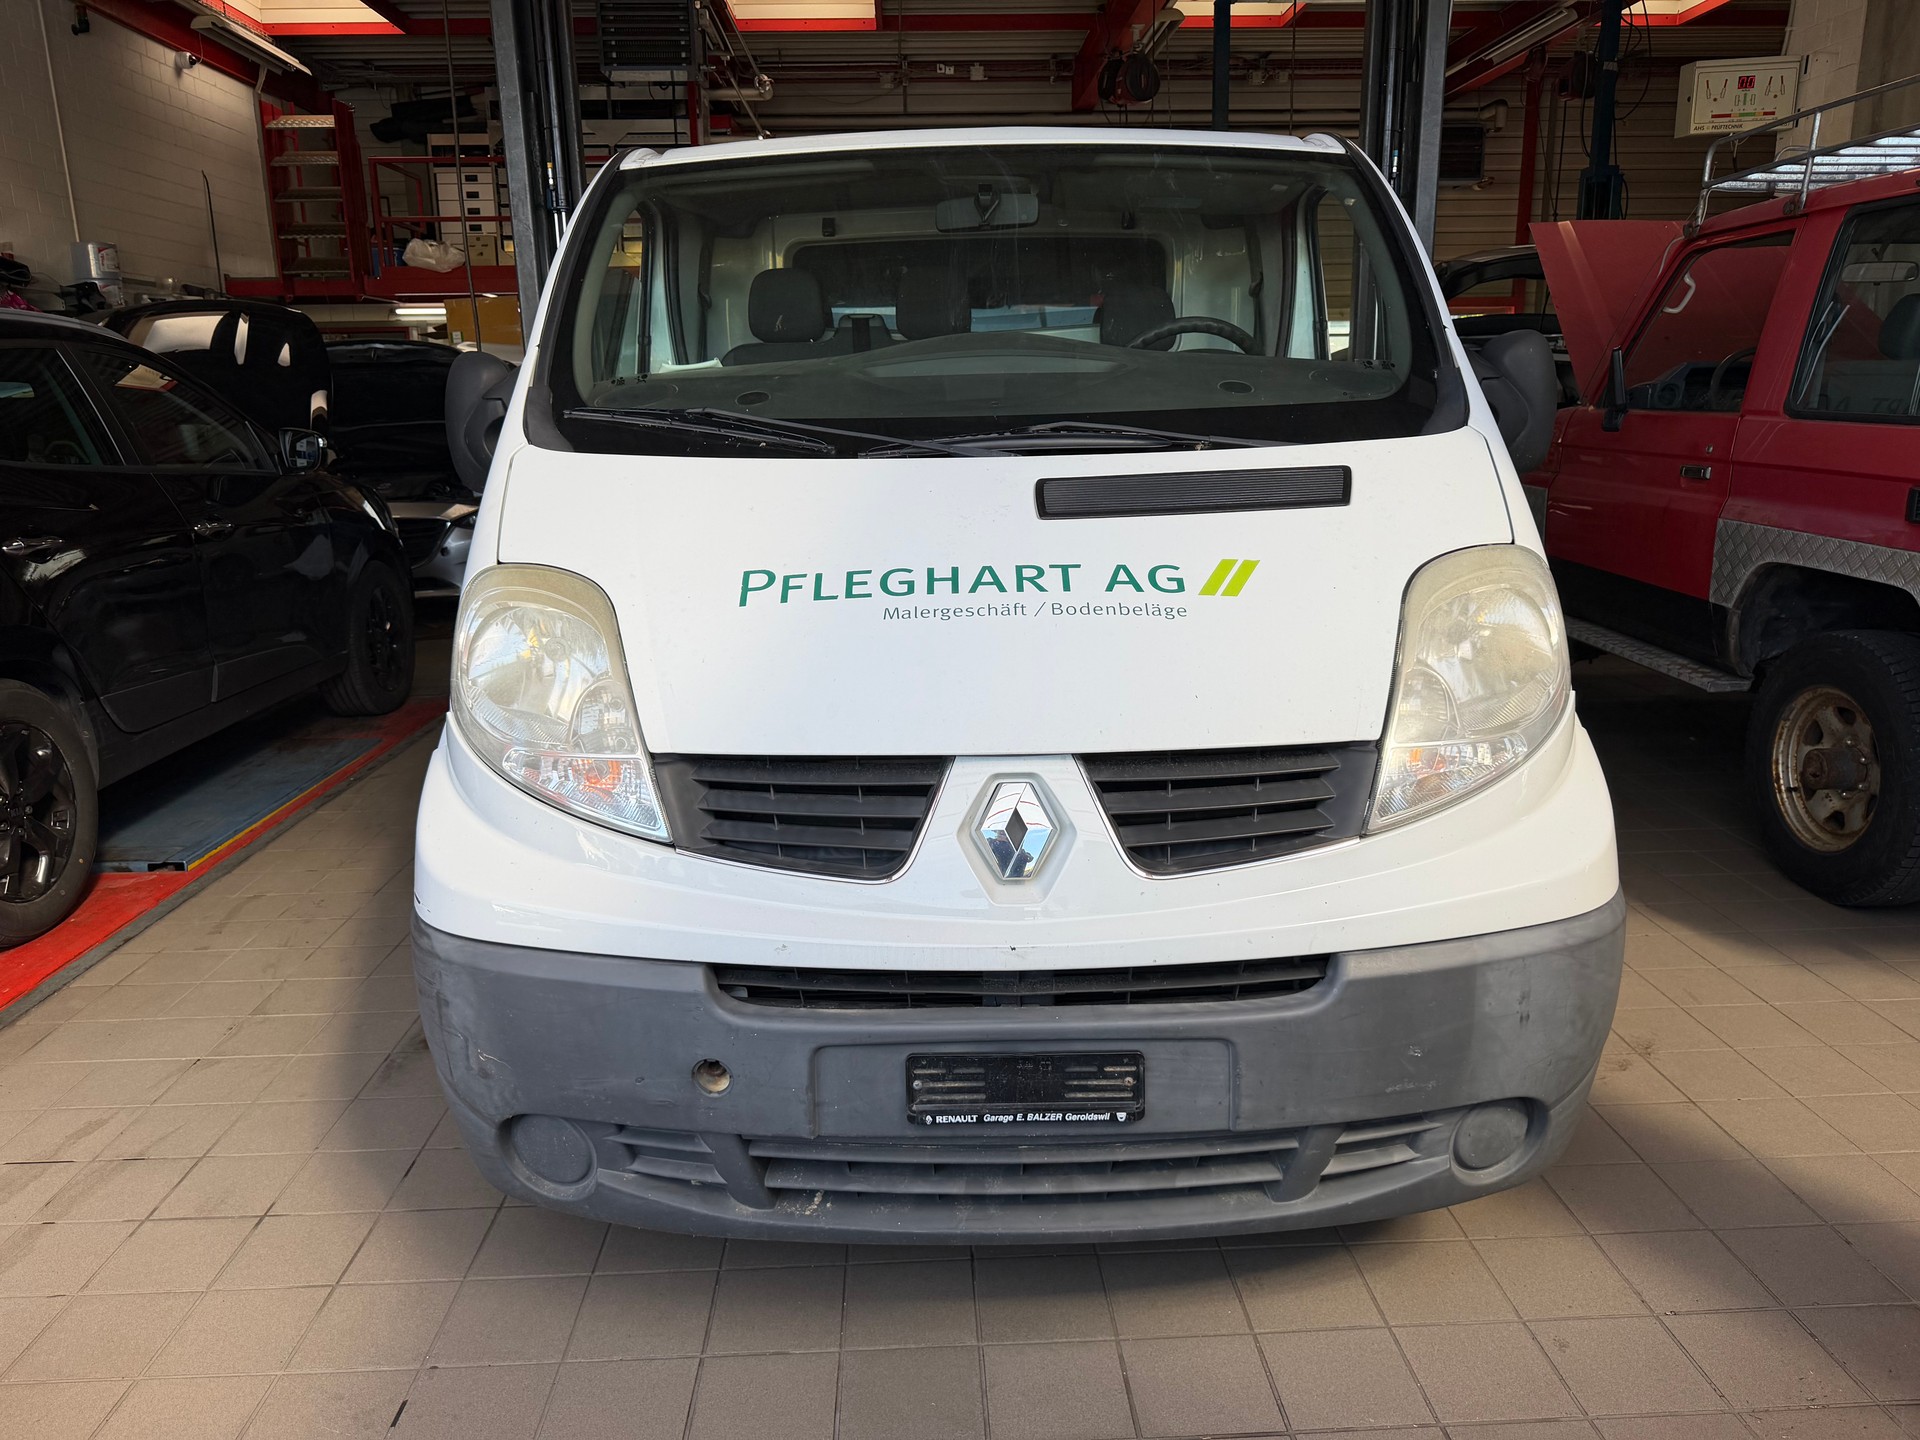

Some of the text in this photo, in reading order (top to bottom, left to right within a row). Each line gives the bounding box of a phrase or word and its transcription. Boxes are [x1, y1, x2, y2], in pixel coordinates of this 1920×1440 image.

[738, 563, 1186, 608] PFLEGHART AG
[883, 602, 1027, 621] Malergeschäft
[1051, 601, 1187, 621] Bodenbeläge
[935, 1112, 1111, 1124] RENAULT Garage E. BALZER Geroldswil
